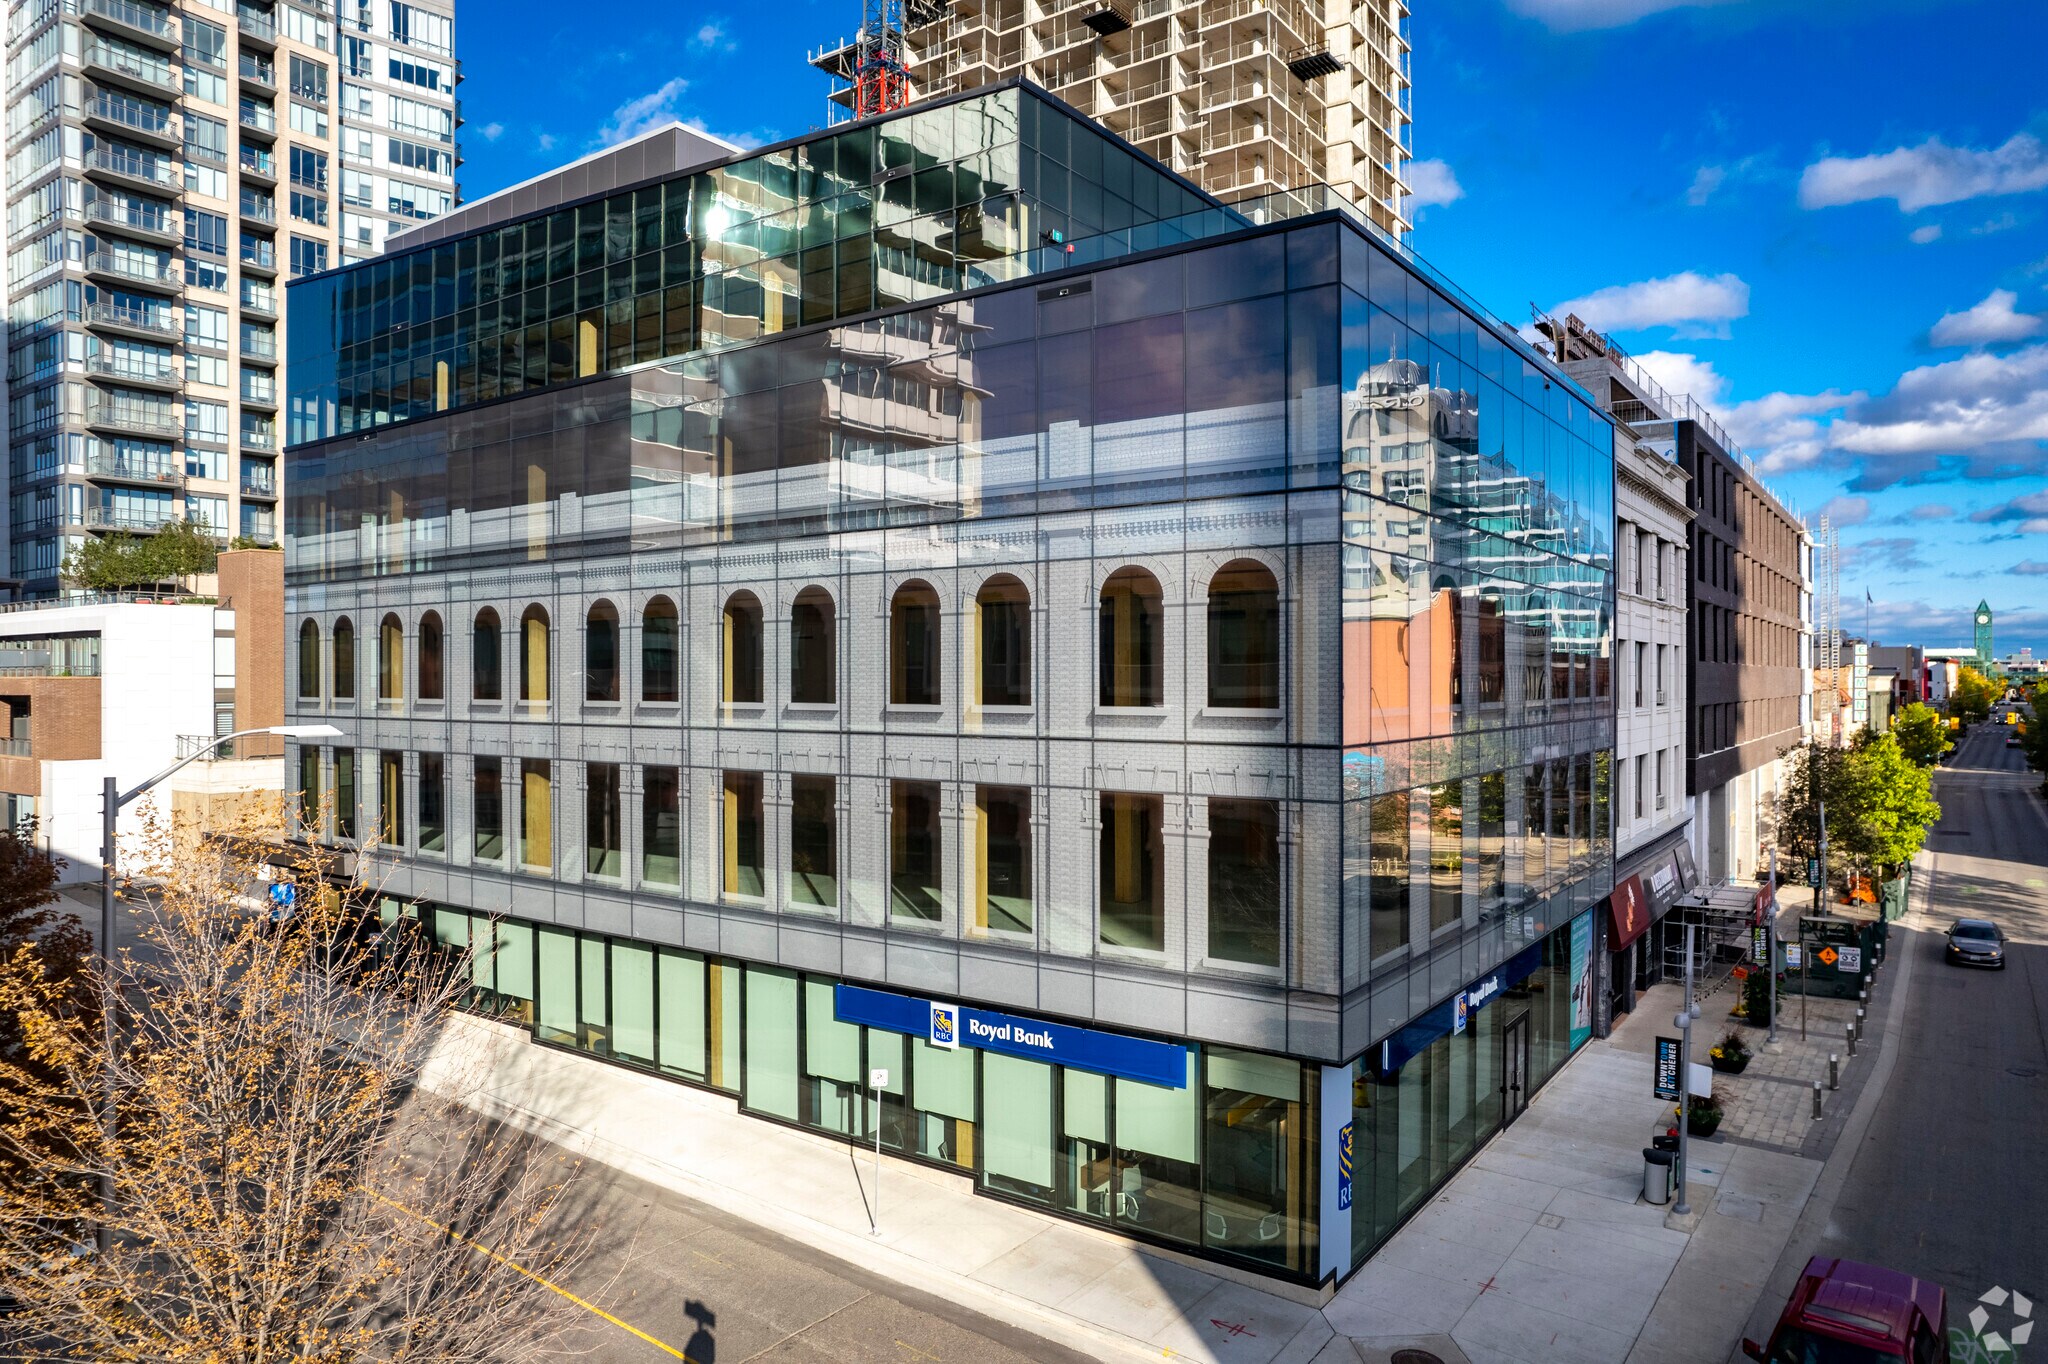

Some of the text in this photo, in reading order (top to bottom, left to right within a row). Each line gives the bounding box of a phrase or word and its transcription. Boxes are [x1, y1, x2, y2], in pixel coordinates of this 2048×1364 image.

[1856, 645, 1866, 720] ELEMENT
[935, 1031, 952, 1041] RBC
[969, 1018, 1054, 1050] Royal Bank
[1659, 1041, 1669, 1088] DOWNTOWN
[1667, 1043, 1677, 1090] KITCHENER
